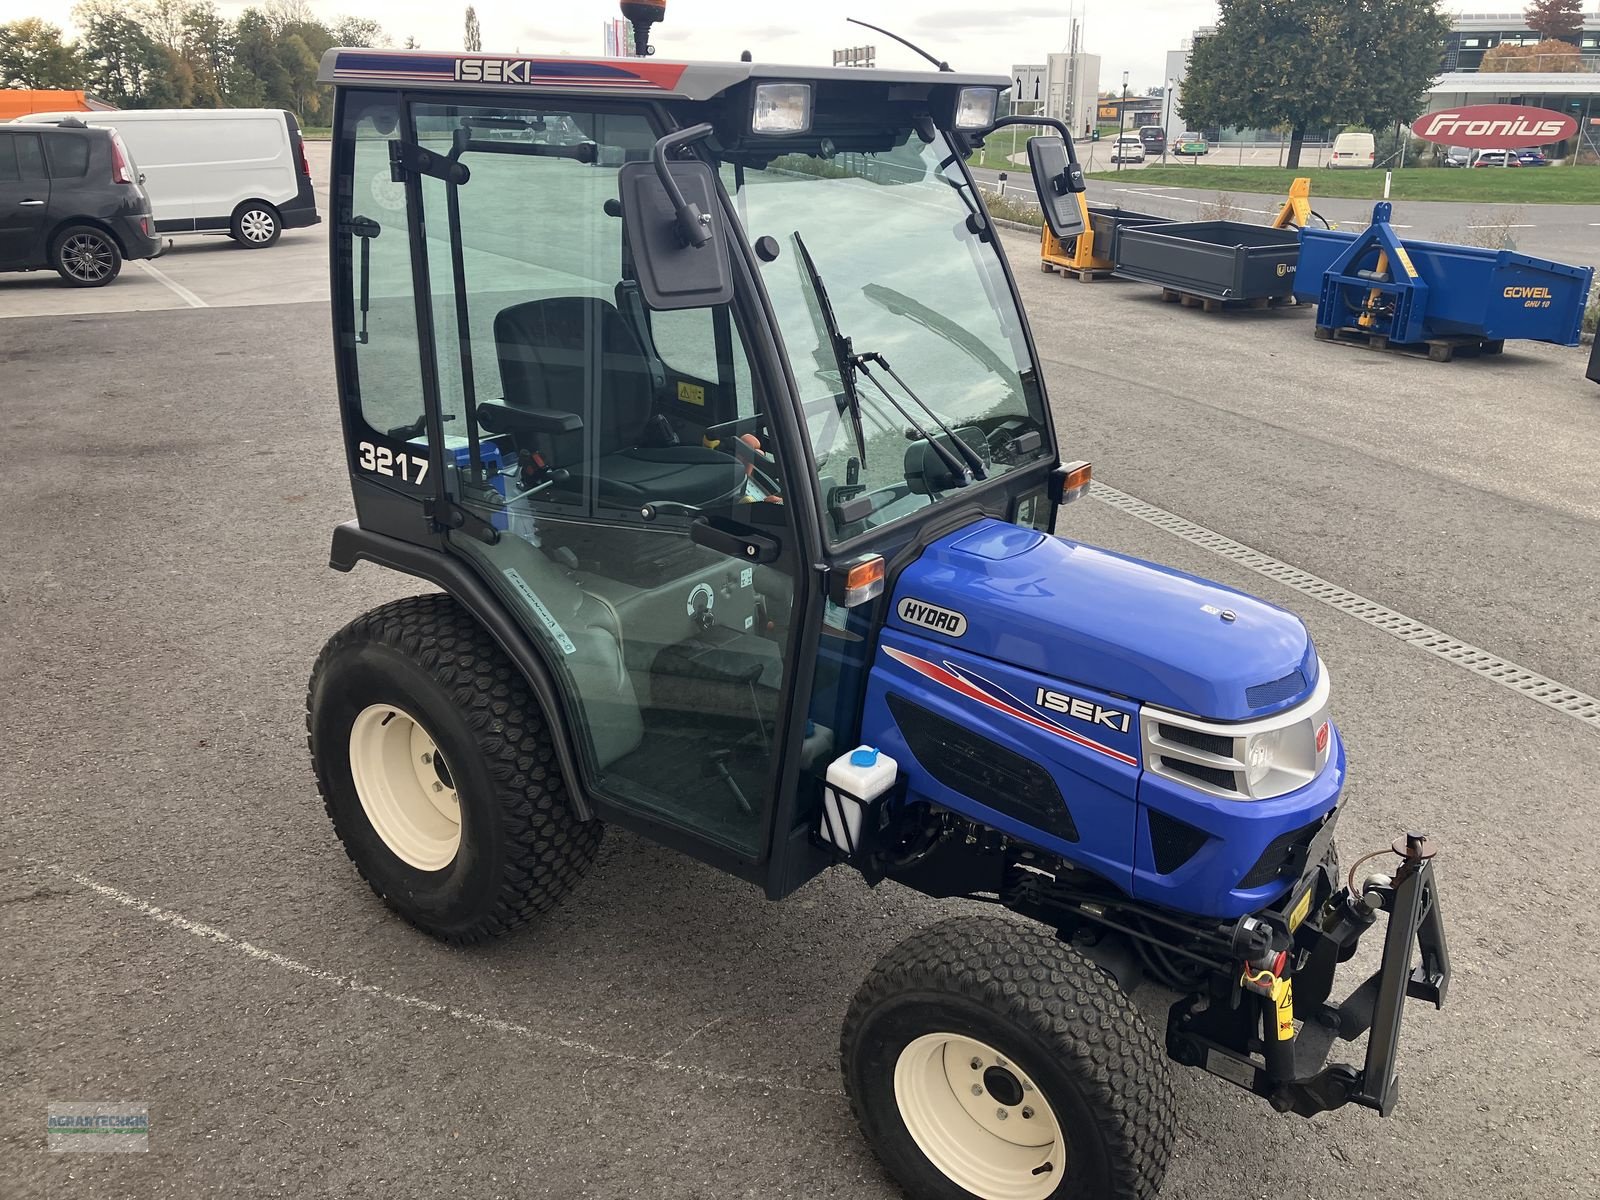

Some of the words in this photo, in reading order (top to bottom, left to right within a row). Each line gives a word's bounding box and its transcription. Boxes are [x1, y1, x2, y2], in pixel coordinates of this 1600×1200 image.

[454, 59, 531, 83] ISEKI
[1424, 114, 1566, 137] Fronius
[359, 441, 429, 485] 3217
[904, 602, 960, 632] HYDRO
[1035, 687, 1131, 733] ISEKI
